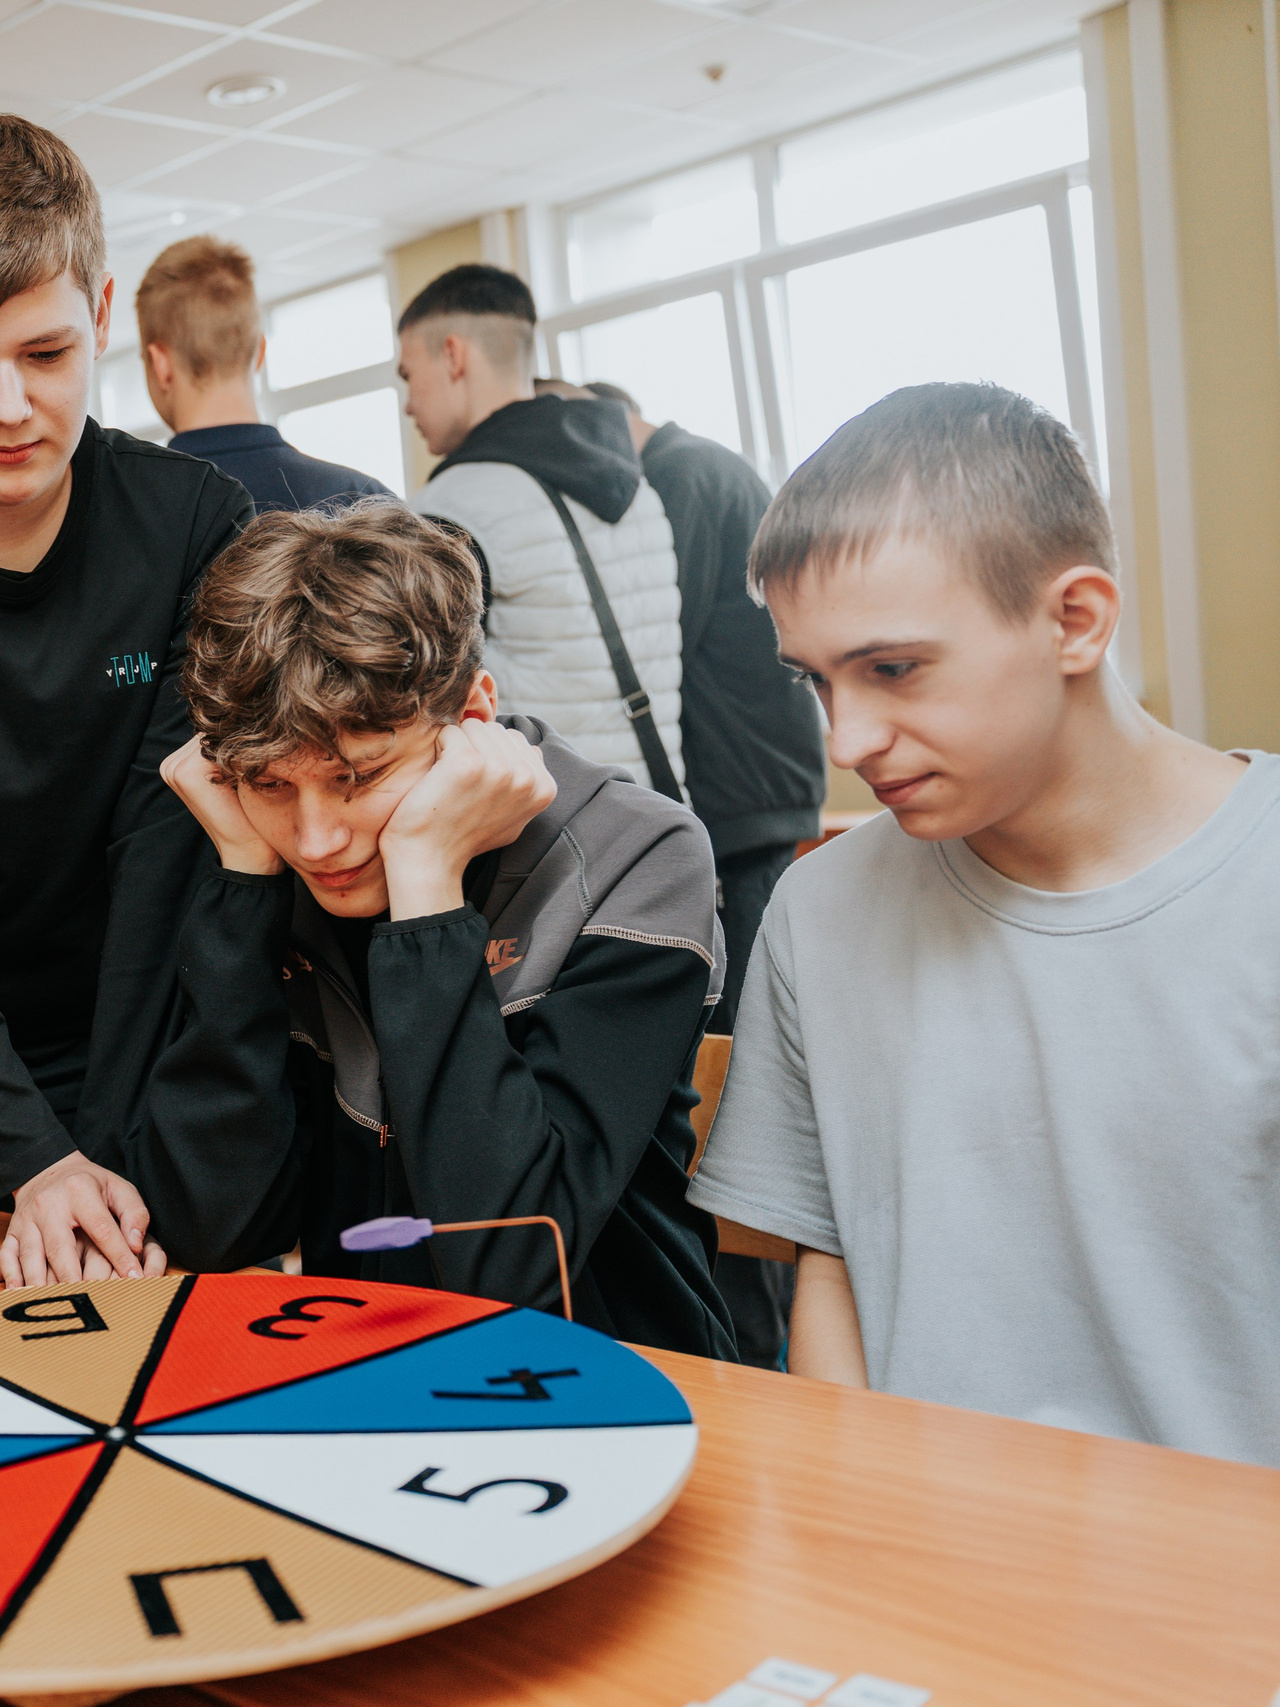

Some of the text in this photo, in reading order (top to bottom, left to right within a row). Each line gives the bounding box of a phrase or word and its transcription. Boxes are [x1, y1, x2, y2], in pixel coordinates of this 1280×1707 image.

[247, 1294, 369, 1341] 3
[429, 1367, 581, 1401] 4
[396, 1466, 569, 1515] 5
